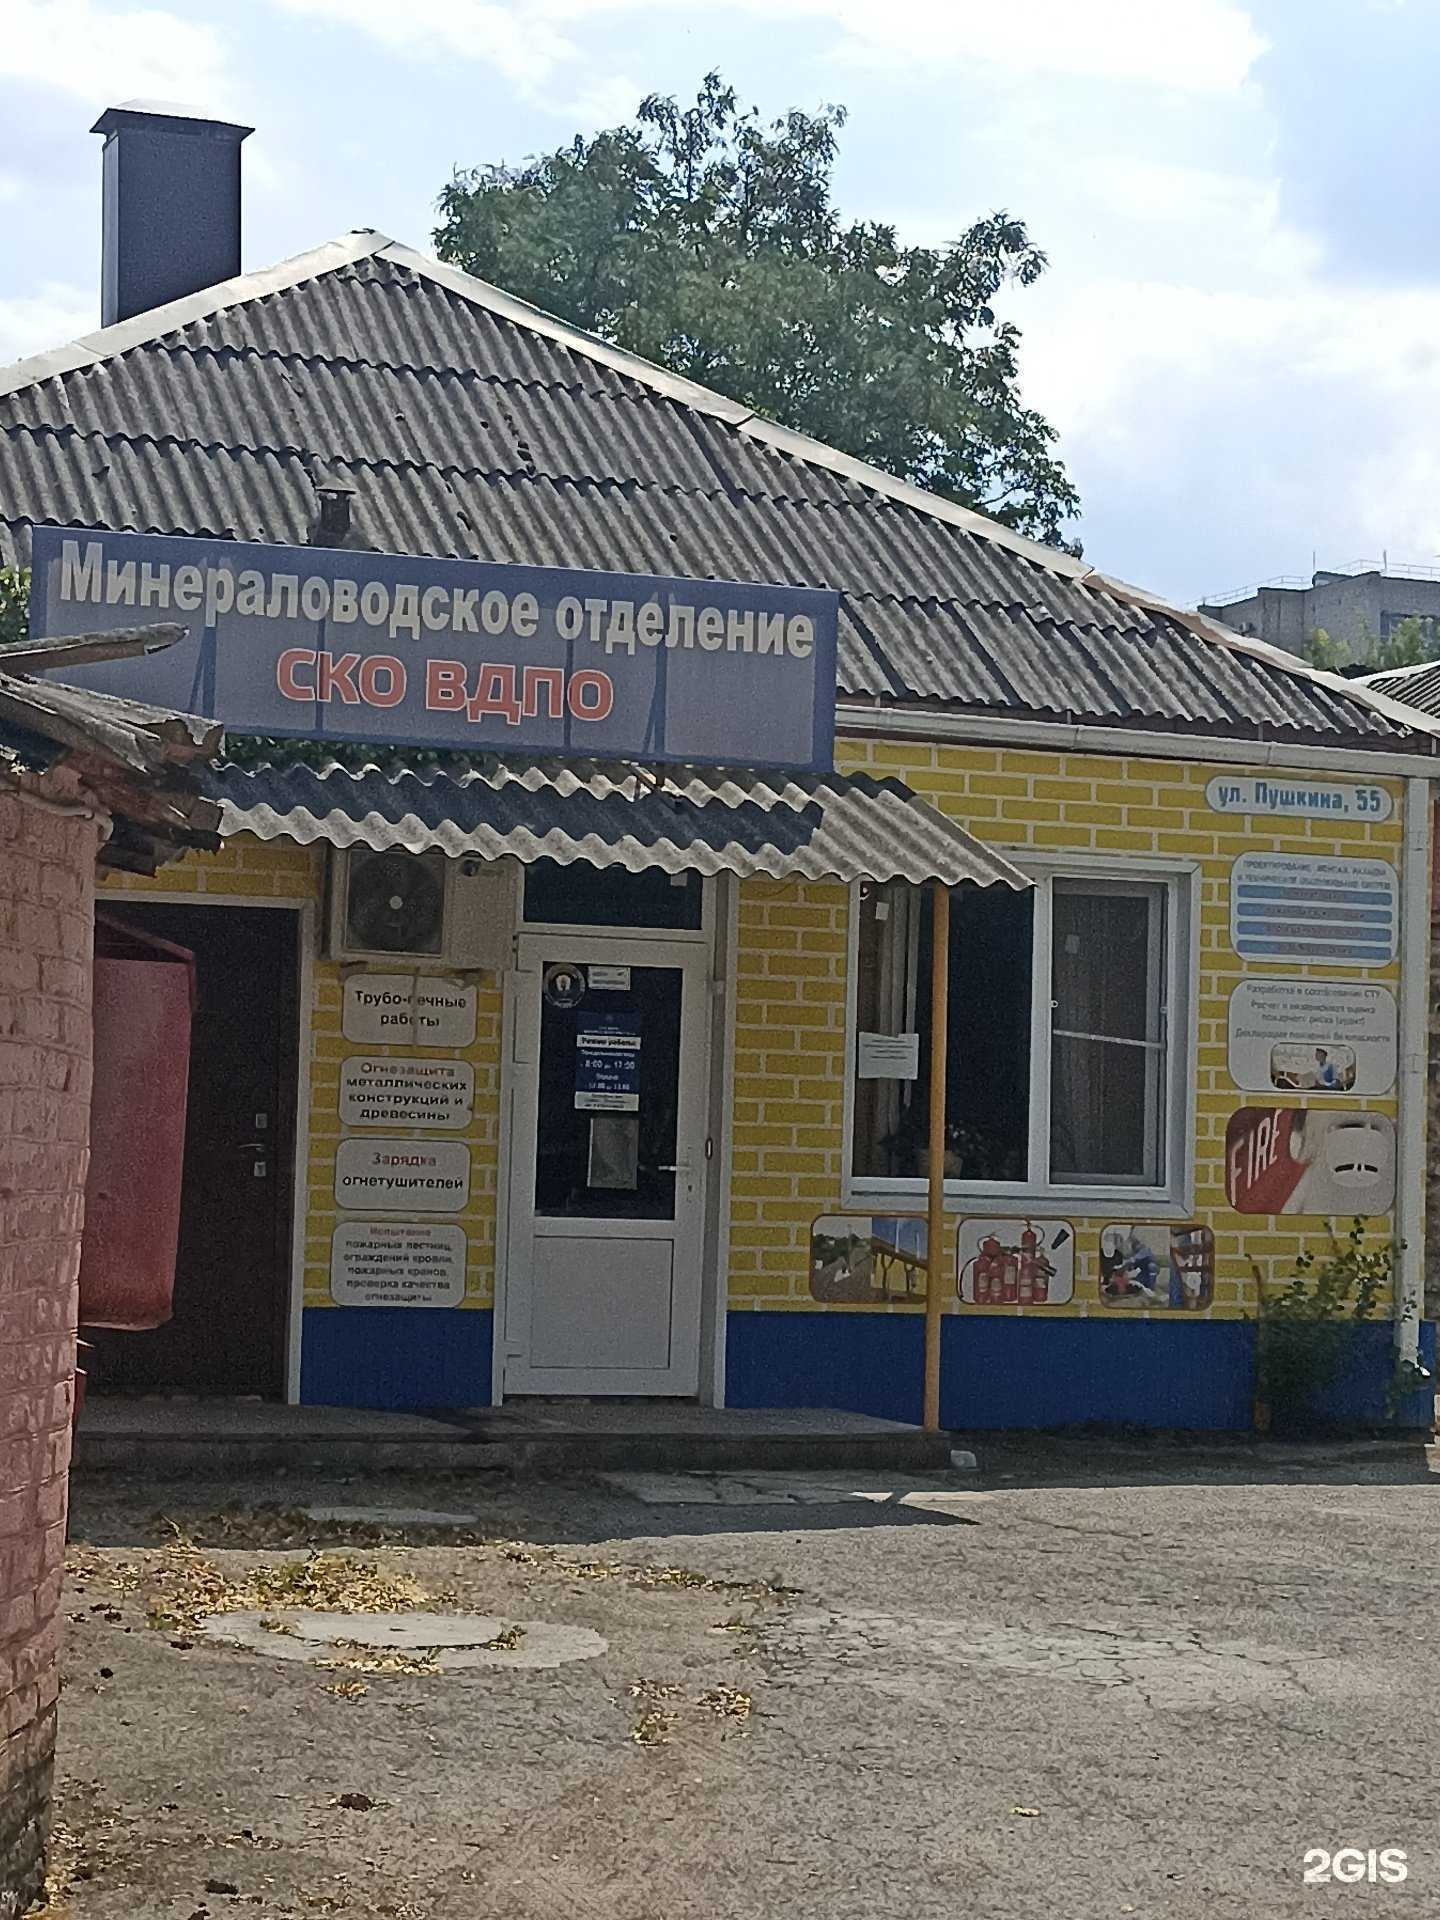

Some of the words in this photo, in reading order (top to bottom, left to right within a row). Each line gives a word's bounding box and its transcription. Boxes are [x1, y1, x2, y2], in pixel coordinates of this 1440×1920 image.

[60, 539, 540, 641] Минераловодское
[555, 596, 814, 658] отделение
[276, 646, 407, 708] СКО
[425, 658, 614, 726] ВДПО
[1218, 786, 1247, 807] ул.
[1255, 782, 1349, 813] Пушкина,
[1356, 789, 1381, 812] 55
[360, 1062, 455, 1077] Огнезащита
[346, 1078, 467, 1090] металлических
[348, 1093, 449, 1106] конструкций
[455, 1097, 463, 1105] и
[360, 1109, 450, 1121] древесины
[372, 1152, 437, 1167] Зарядка
[1230, 1108, 1284, 1207] FIRE
[342, 1176, 463, 1189] огнетушителей
